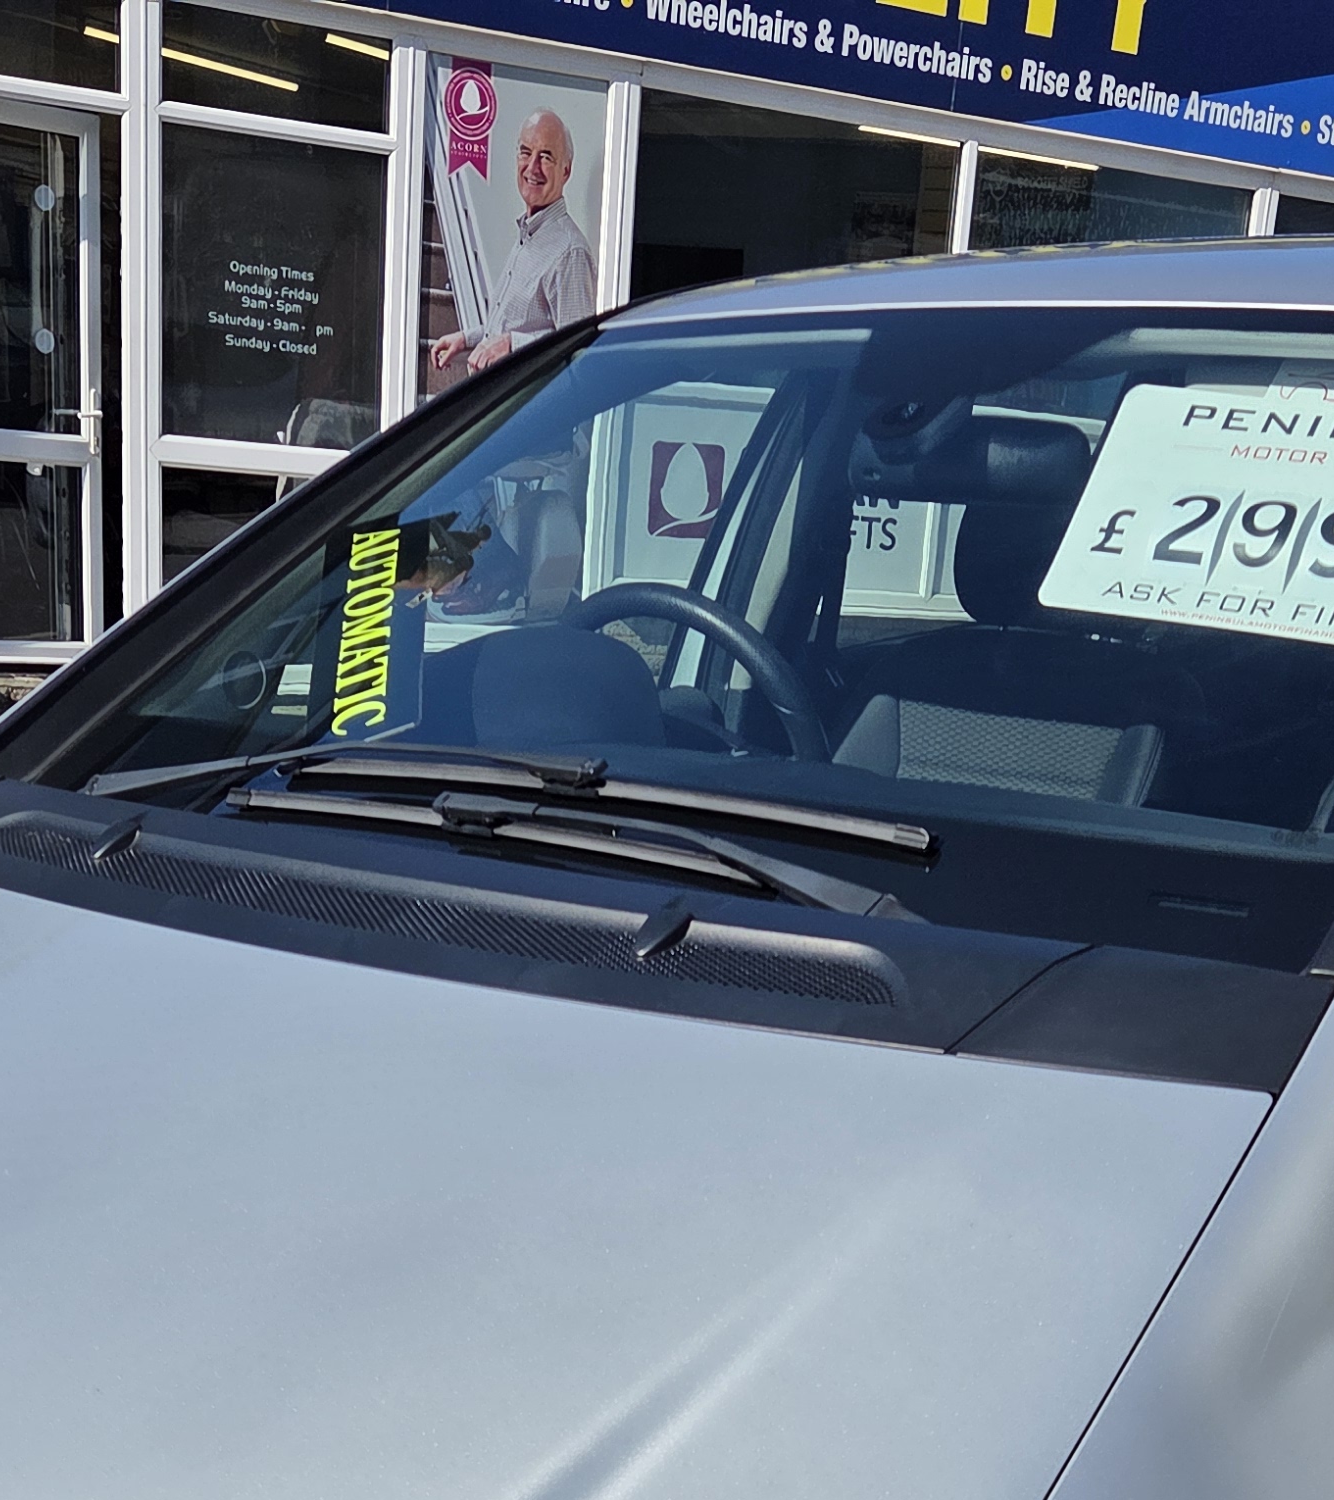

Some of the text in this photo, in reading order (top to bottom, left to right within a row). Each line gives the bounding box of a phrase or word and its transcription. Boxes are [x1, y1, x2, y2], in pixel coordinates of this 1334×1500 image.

[645, 0, 807, 49] Wheelchairs
[814, 18, 835, 55] &
[841, 23, 992, 84] Powerchairs
[1020, 58, 1069, 98] Rise
[1075, 69, 1094, 102] &
[1099, 74, 1179, 118] Recline
[1183, 91, 1294, 138] Armchairs
[451, 141, 487, 153] ACORN
[229, 261, 314, 282] Opening Times
[224, 280, 272, 299] Monday
[281, 287, 319, 304] Friday
[241, 296, 268, 310] 9am
[276, 299, 302, 315] 5pm
[208, 311, 265, 331] Saturday
[273, 318, 299, 332] 9am
[316, 325, 333, 337] pm
[225, 334, 270, 352] Sunday
[279, 340, 317, 355] Closed
[1230, 444, 1328, 465] MOTOR
[1090, 509, 1137, 555] £
[1101, 581, 1183, 605] ASK
[1196, 591, 1276, 618] FOR
[331, 528, 401, 736] AUTOMATIC
